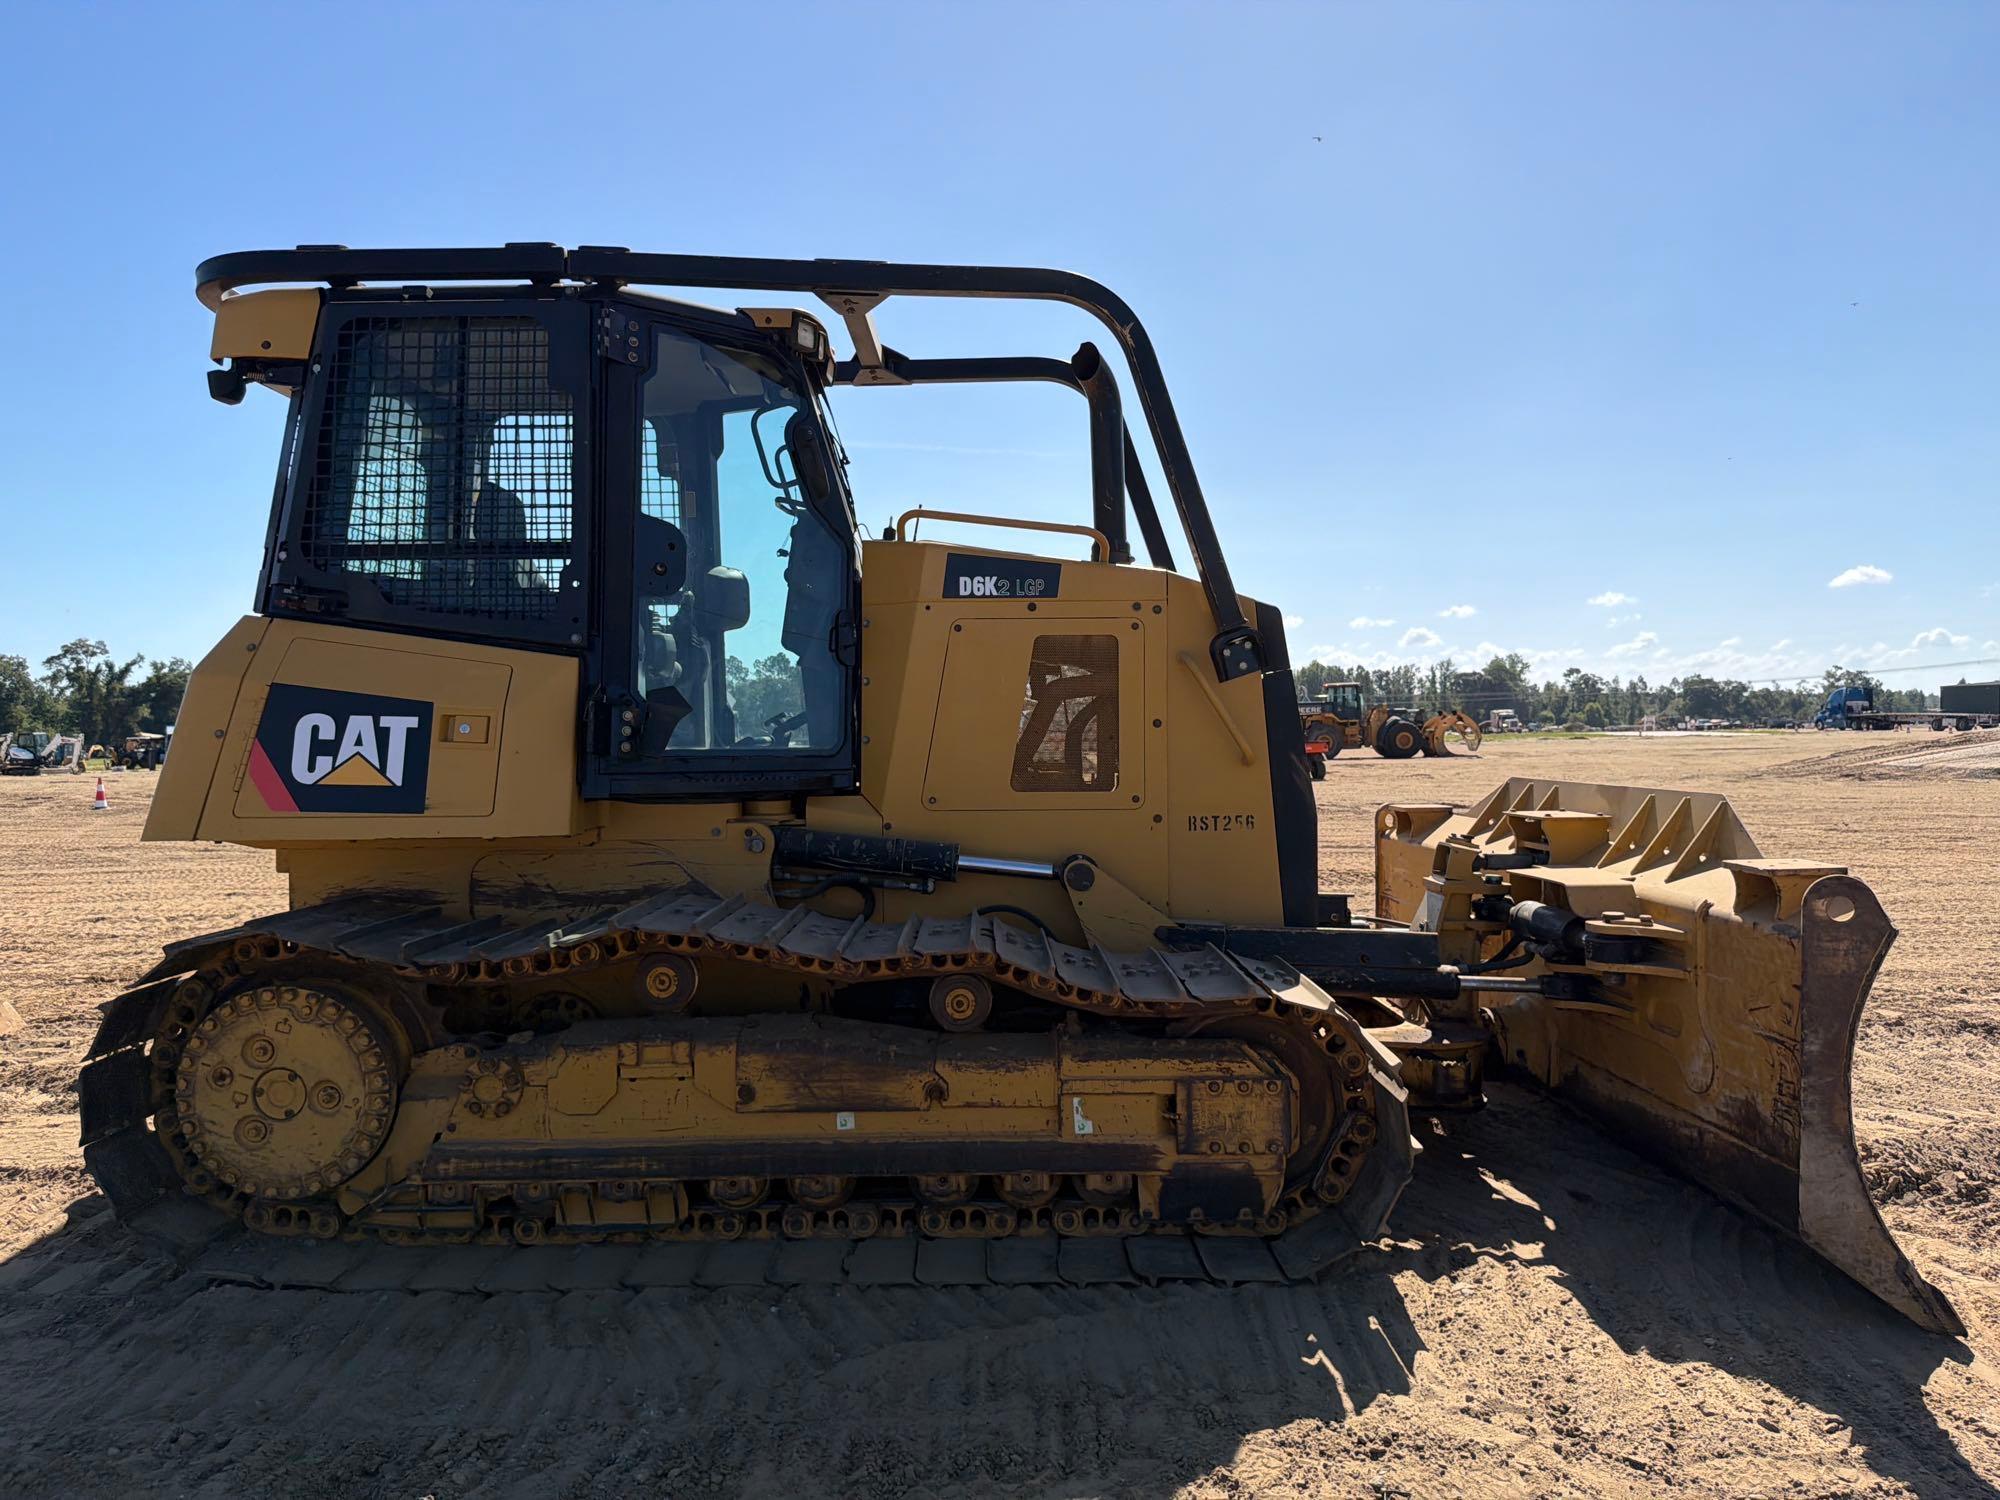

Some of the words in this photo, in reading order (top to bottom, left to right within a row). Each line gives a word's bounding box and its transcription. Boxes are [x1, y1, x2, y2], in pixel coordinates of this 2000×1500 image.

[1016, 578, 1045, 596] LGP
[1298, 706, 1322, 714] EERE
[291, 712, 419, 786] CAT
